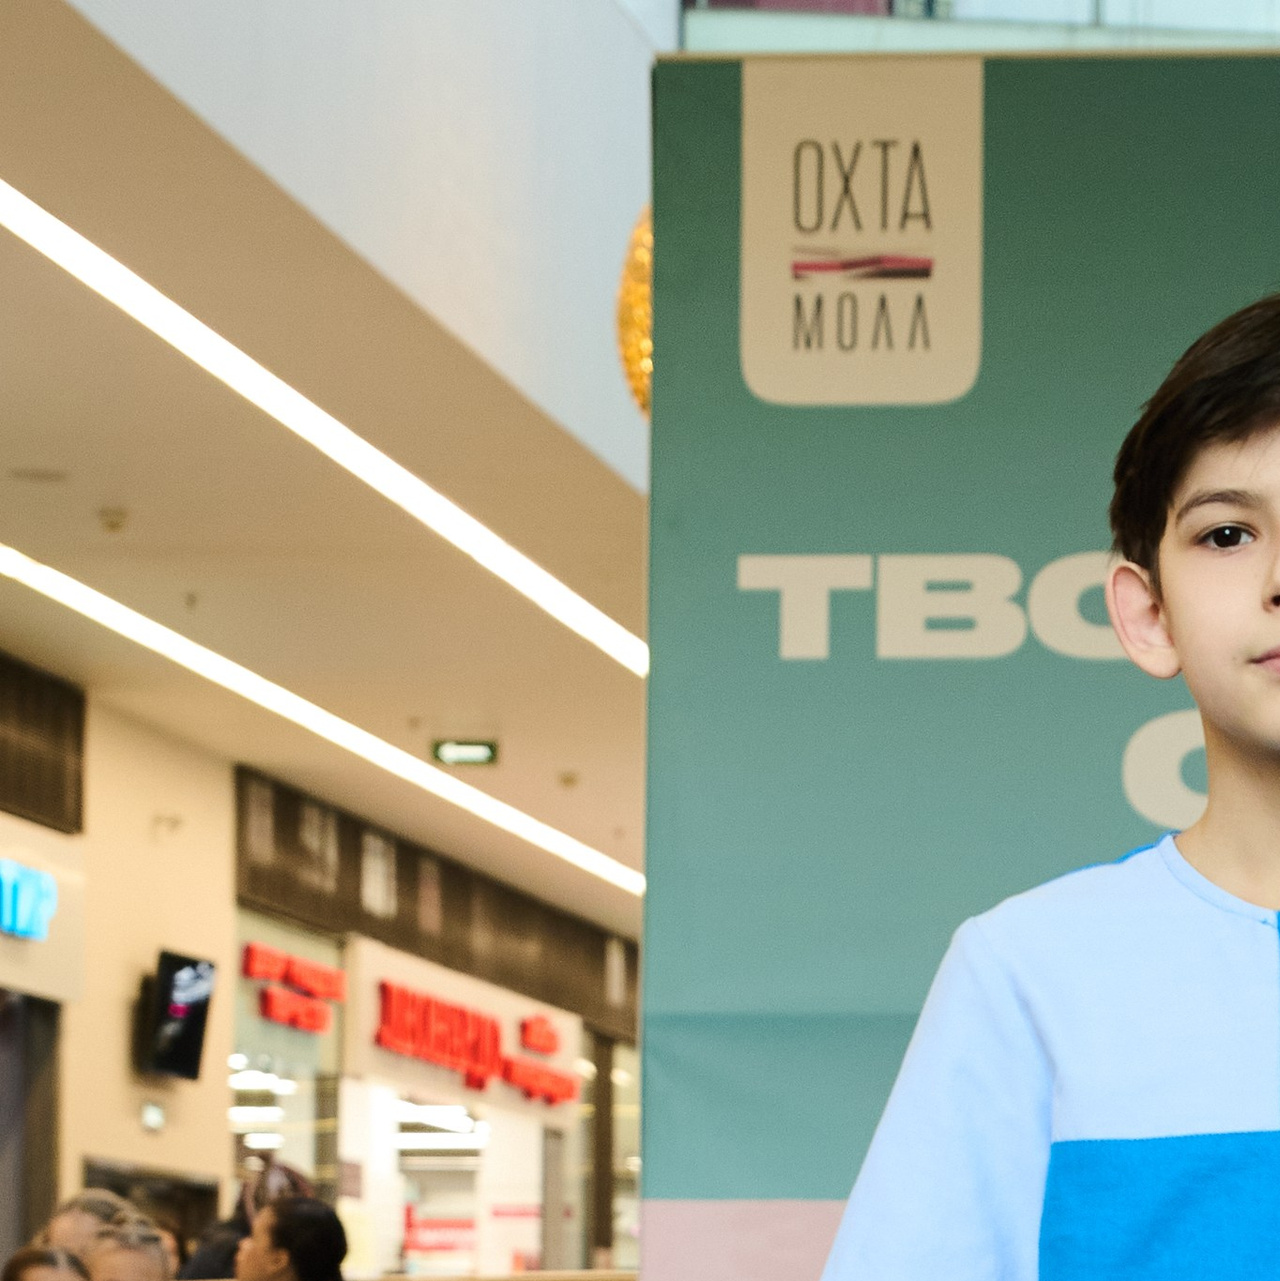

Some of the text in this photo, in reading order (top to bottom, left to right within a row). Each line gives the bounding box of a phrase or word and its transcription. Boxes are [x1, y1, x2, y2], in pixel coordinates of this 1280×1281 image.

[791, 140, 933, 234] ОХТА
[792, 293, 931, 351] МОЛЛ
[737, 550, 1131, 661] ТВО
